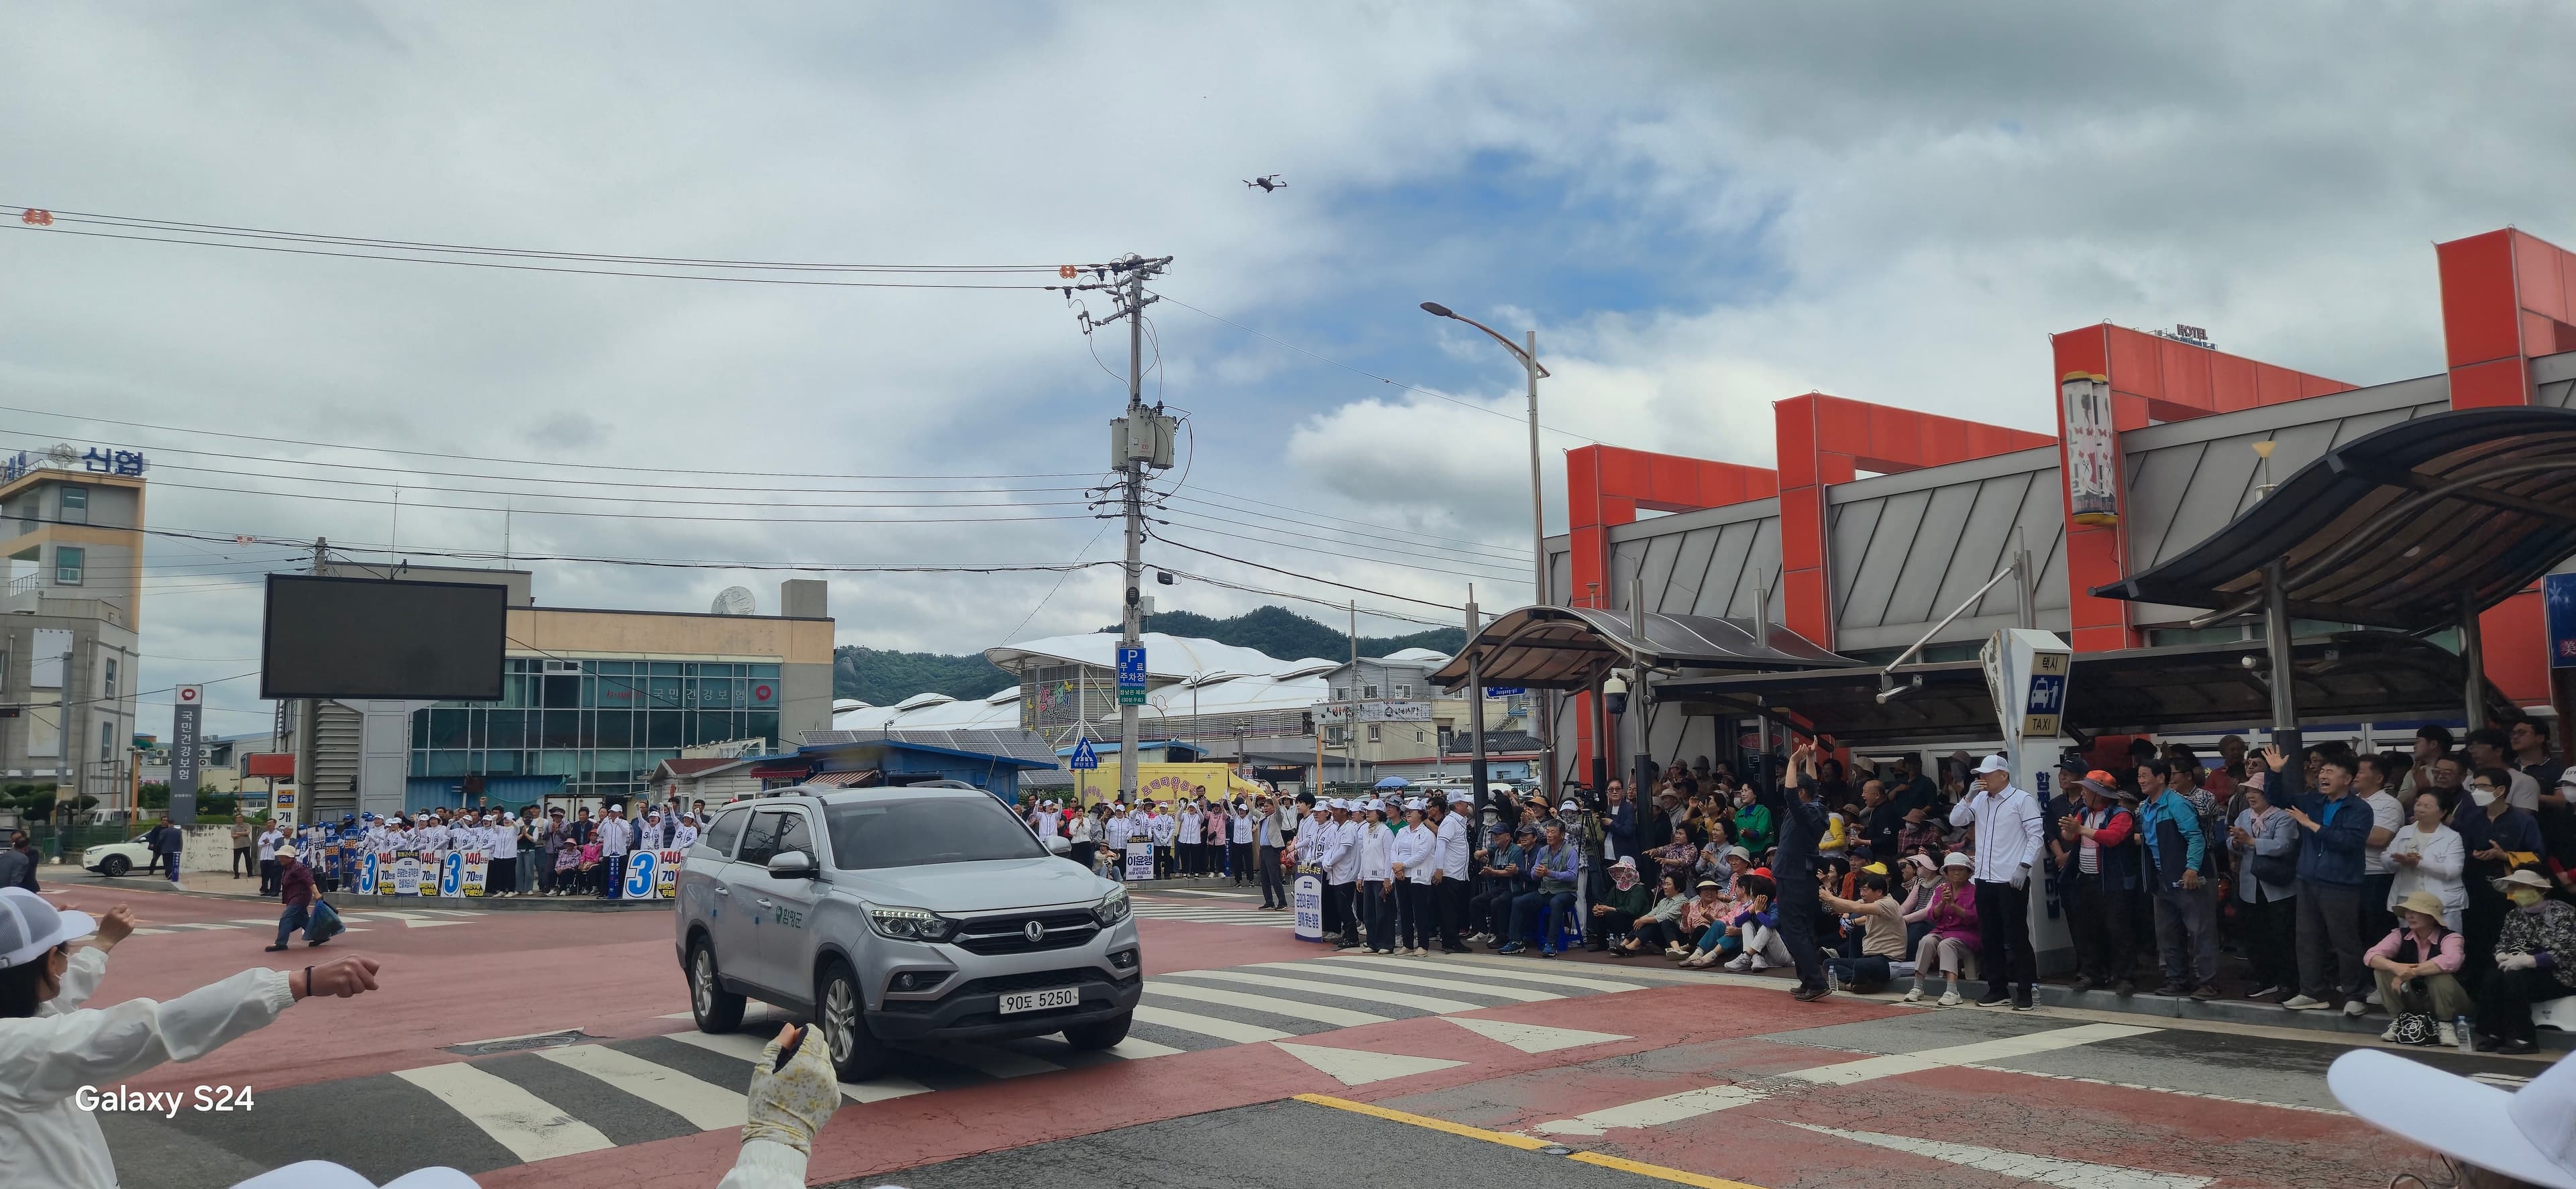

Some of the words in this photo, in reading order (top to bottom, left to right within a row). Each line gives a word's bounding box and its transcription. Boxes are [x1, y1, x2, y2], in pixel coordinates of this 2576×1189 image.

[2177, 324, 2208, 340] HOTEL
[82, 447, 143, 476] 신협
[1128, 650, 1138, 663] P
[2043, 657, 2058, 671] 택시
[1120, 672, 1144, 681] 주차장
[2033, 719, 2050, 730] TAXI
[179, 711, 193, 780] 국민건강보험
[1146, 844, 1152, 854] 3
[1128, 856, 1152, 866] 이윤행
[361, 852, 376, 891] 3
[444, 853, 462, 893] 3
[628, 854, 655, 895] 3
[783, 907, 802, 929] 함평군
[1007, 995, 1032, 1011] 90도
[1039, 990, 1071, 1007] 5250
